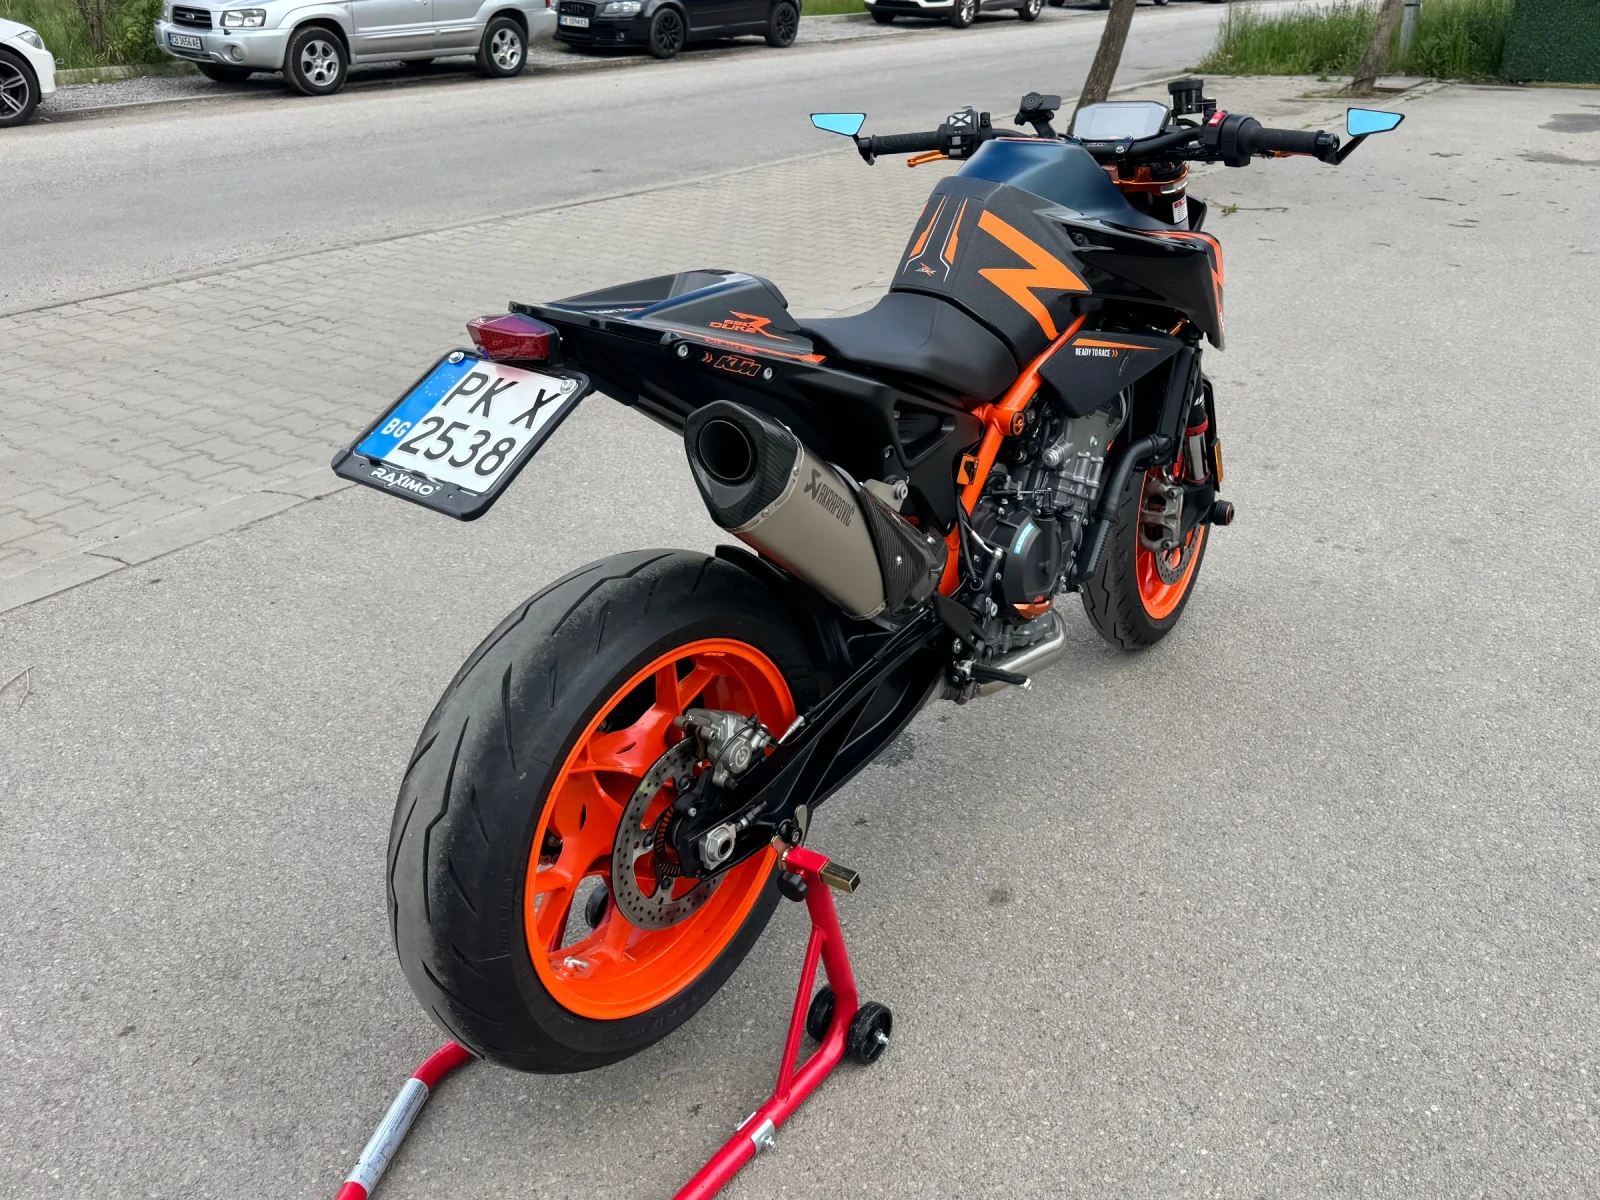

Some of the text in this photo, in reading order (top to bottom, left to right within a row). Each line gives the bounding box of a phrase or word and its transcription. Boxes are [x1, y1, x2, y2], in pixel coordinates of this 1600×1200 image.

[192, 38, 200, 48] AE
[1075, 347, 1111, 358] READY TO RACE
[713, 355, 761, 377] KTM
[441, 371, 562, 430] PK X
[381, 417, 412, 438] BG
[397, 416, 516, 477] 2538
[370, 467, 436, 496] RAXIMO
